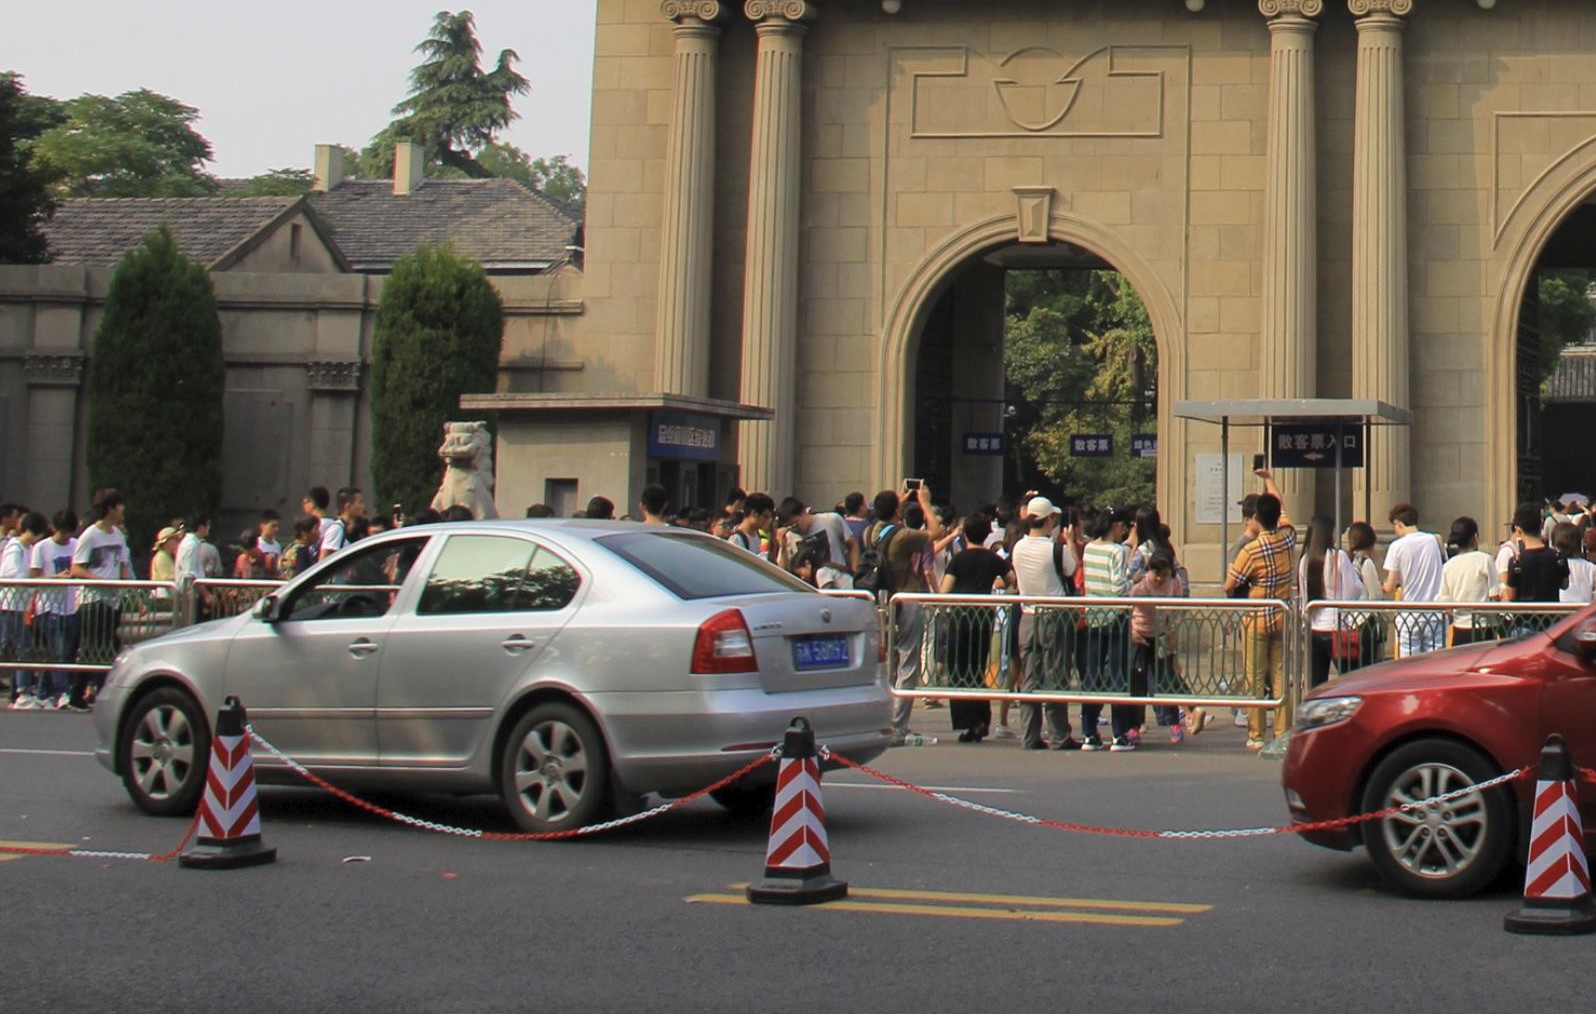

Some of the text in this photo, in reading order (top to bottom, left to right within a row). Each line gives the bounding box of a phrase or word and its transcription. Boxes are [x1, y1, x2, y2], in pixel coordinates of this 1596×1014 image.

[967, 438, 1000, 450] 散客票
[1074, 439, 1108, 451] 散客票
[1134, 440, 1157, 450] 绿色
